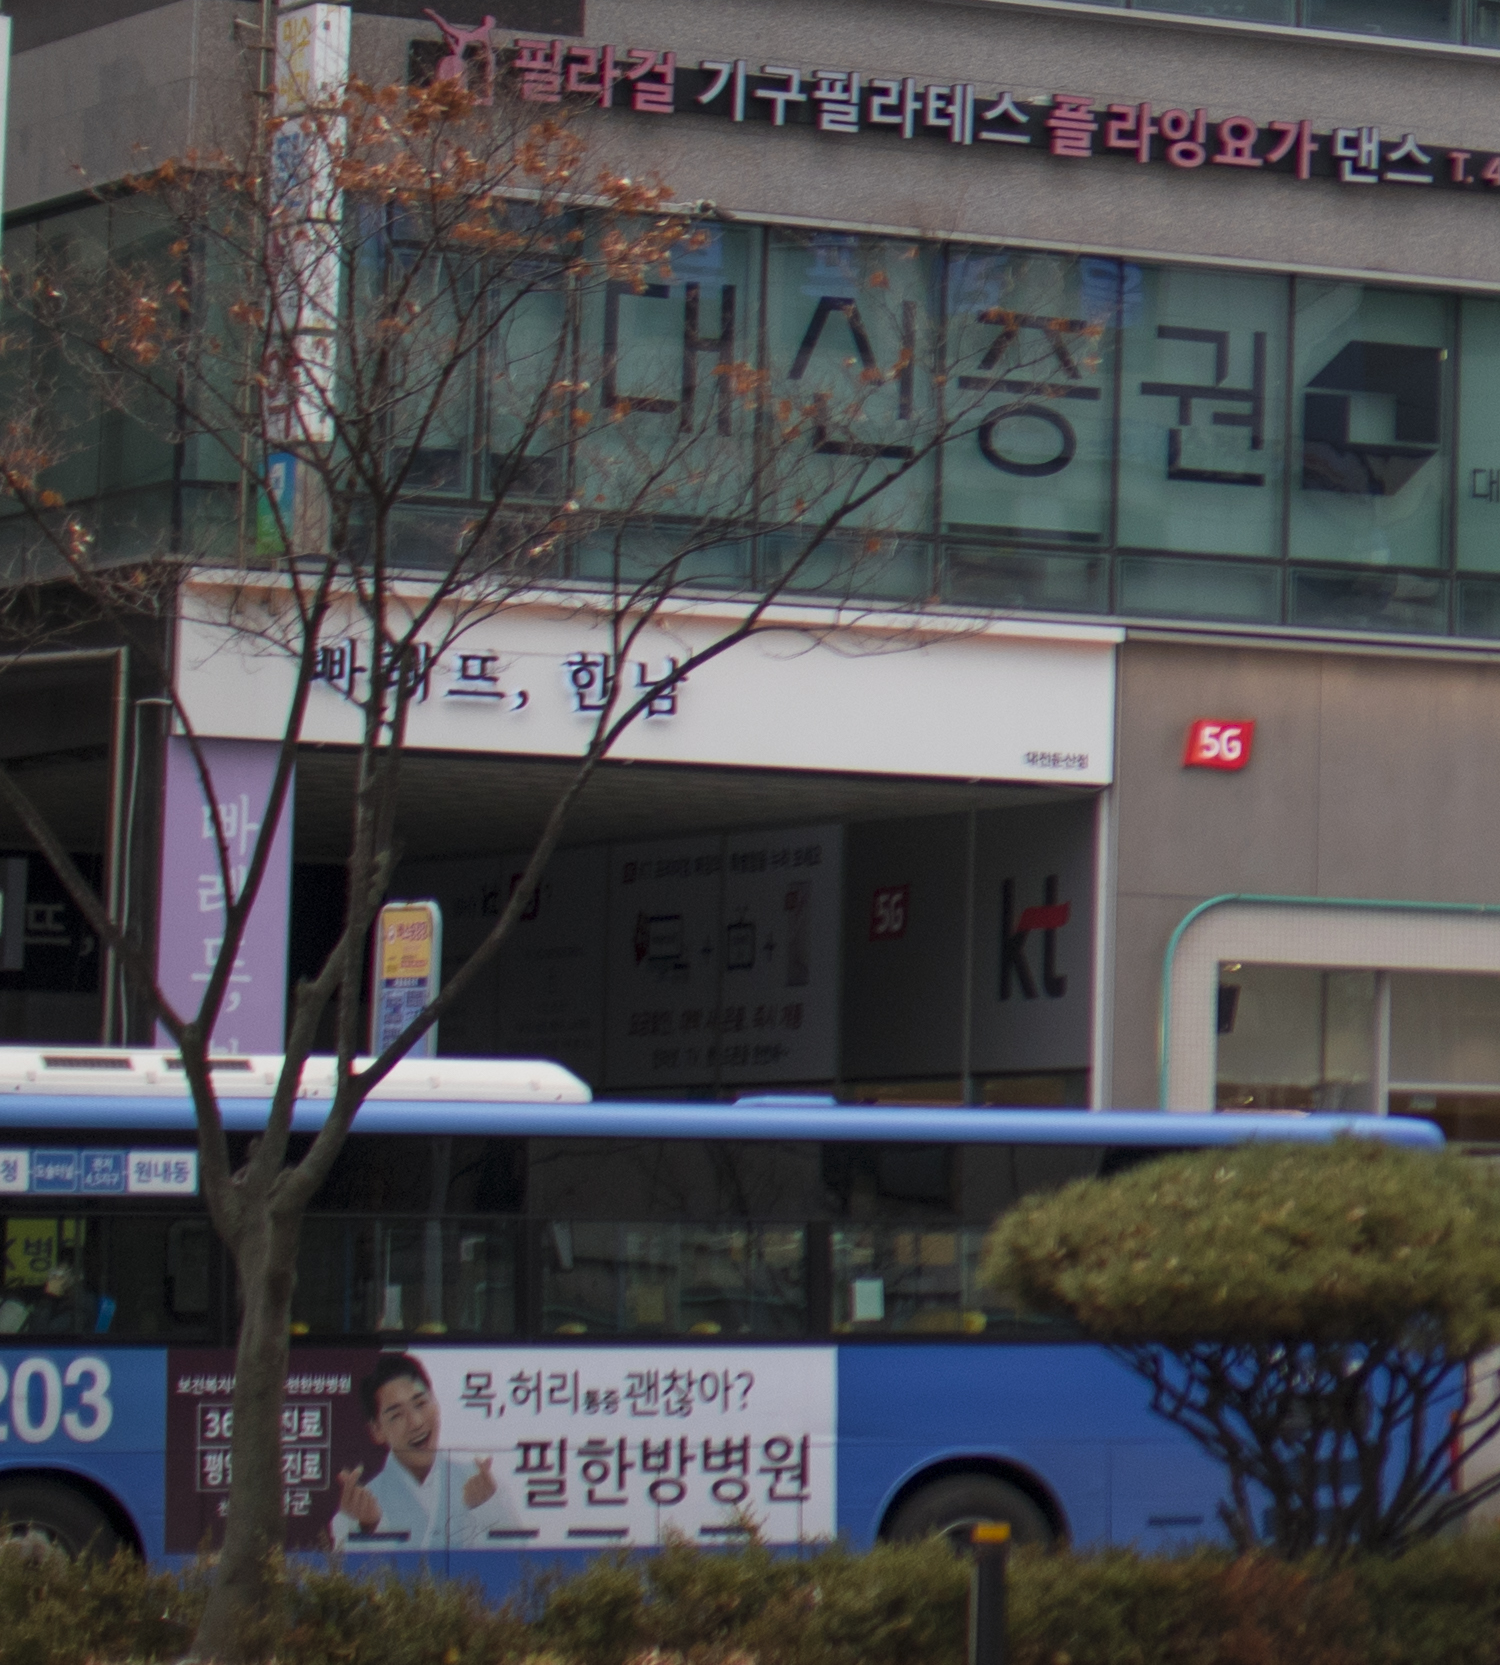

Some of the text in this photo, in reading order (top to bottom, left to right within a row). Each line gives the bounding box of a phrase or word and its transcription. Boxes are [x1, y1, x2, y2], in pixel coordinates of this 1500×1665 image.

[513, 36, 677, 114] 필라걸
[697, 53, 1033, 150] 기구필라테스
[1045, 91, 1321, 184] 플라잉요가
[1330, 126, 1435, 190] 댄스
[1200, 726, 1244, 762] 5G
[873, 892, 906, 934] 5G
[998, 873, 1071, 1002] kt
[134, 1160, 191, 1185] 원내동
[460, 1370, 581, 1422] 목,허리
[623, 1370, 756, 1419] 괜찮아?
[514, 1433, 812, 1509] 필한방병원
